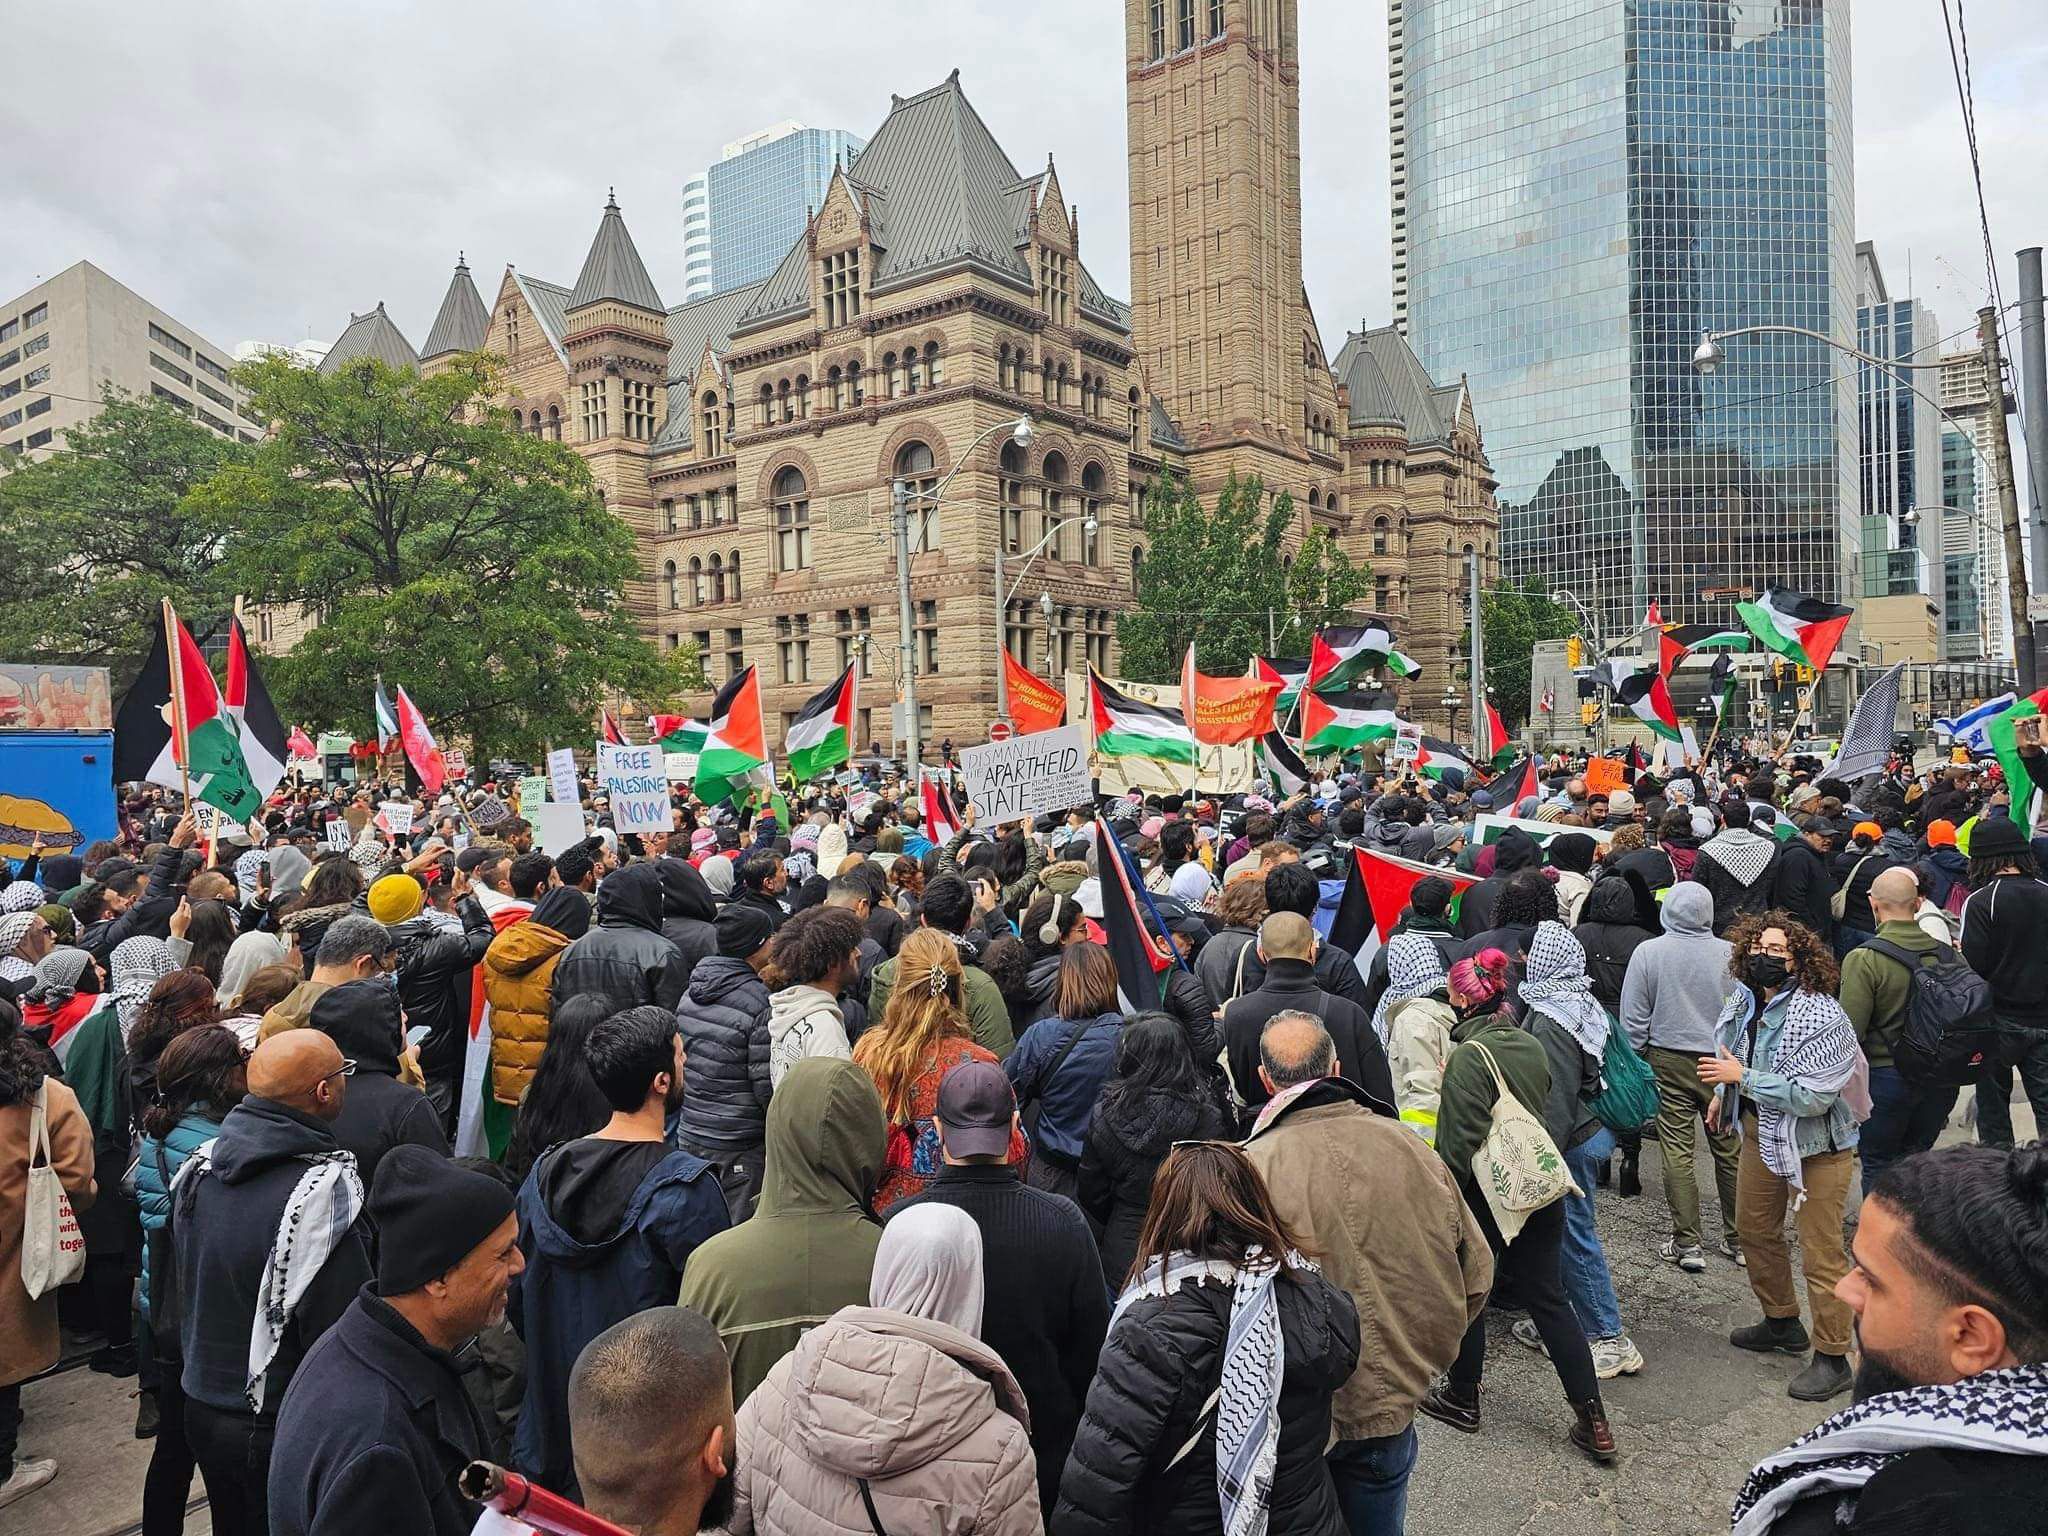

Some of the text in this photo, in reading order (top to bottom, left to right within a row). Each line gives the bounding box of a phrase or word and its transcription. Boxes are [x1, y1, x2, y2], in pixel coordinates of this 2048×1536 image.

[1017, 694, 1060, 716] TRUGGLE!
[615, 751, 651, 769] FREE
[968, 737, 1051, 768] DISMANTLE
[983, 747, 1078, 791] APARTHEID
[608, 775, 666, 795] PALESTINE
[972, 781, 1033, 819] STATE
[619, 799, 666, 827] NOW
[60, 1239, 85, 1252] toge
